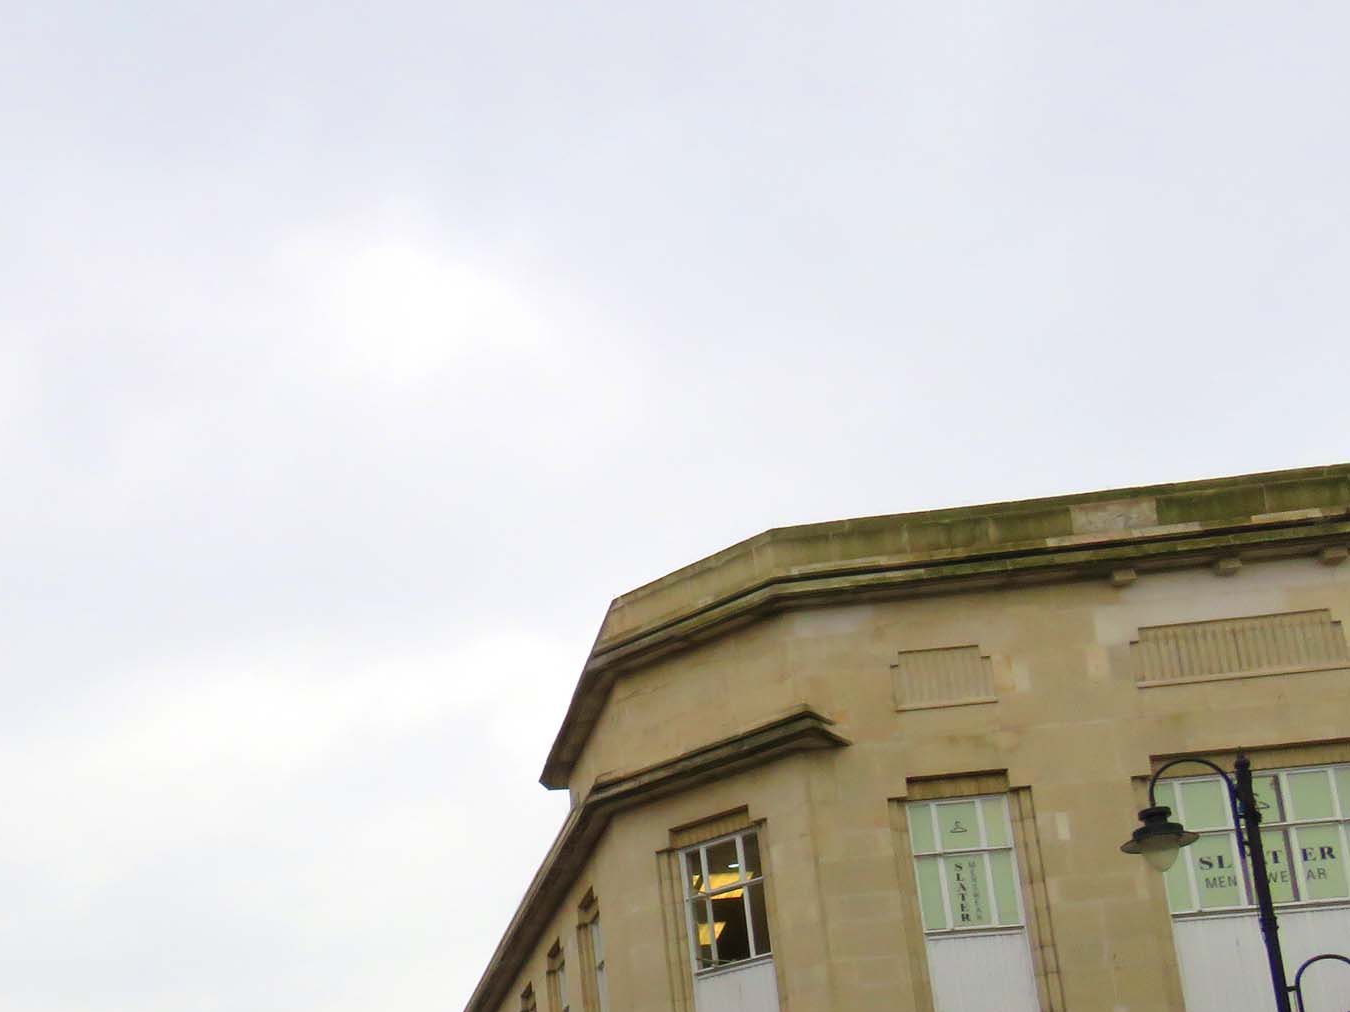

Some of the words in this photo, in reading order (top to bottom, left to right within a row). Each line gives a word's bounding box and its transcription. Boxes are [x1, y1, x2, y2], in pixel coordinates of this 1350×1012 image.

[1198, 845, 1336, 871] SLTER
[1205, 867, 1327, 889] MENWEAR
[954, 863, 970, 922] SLATER
